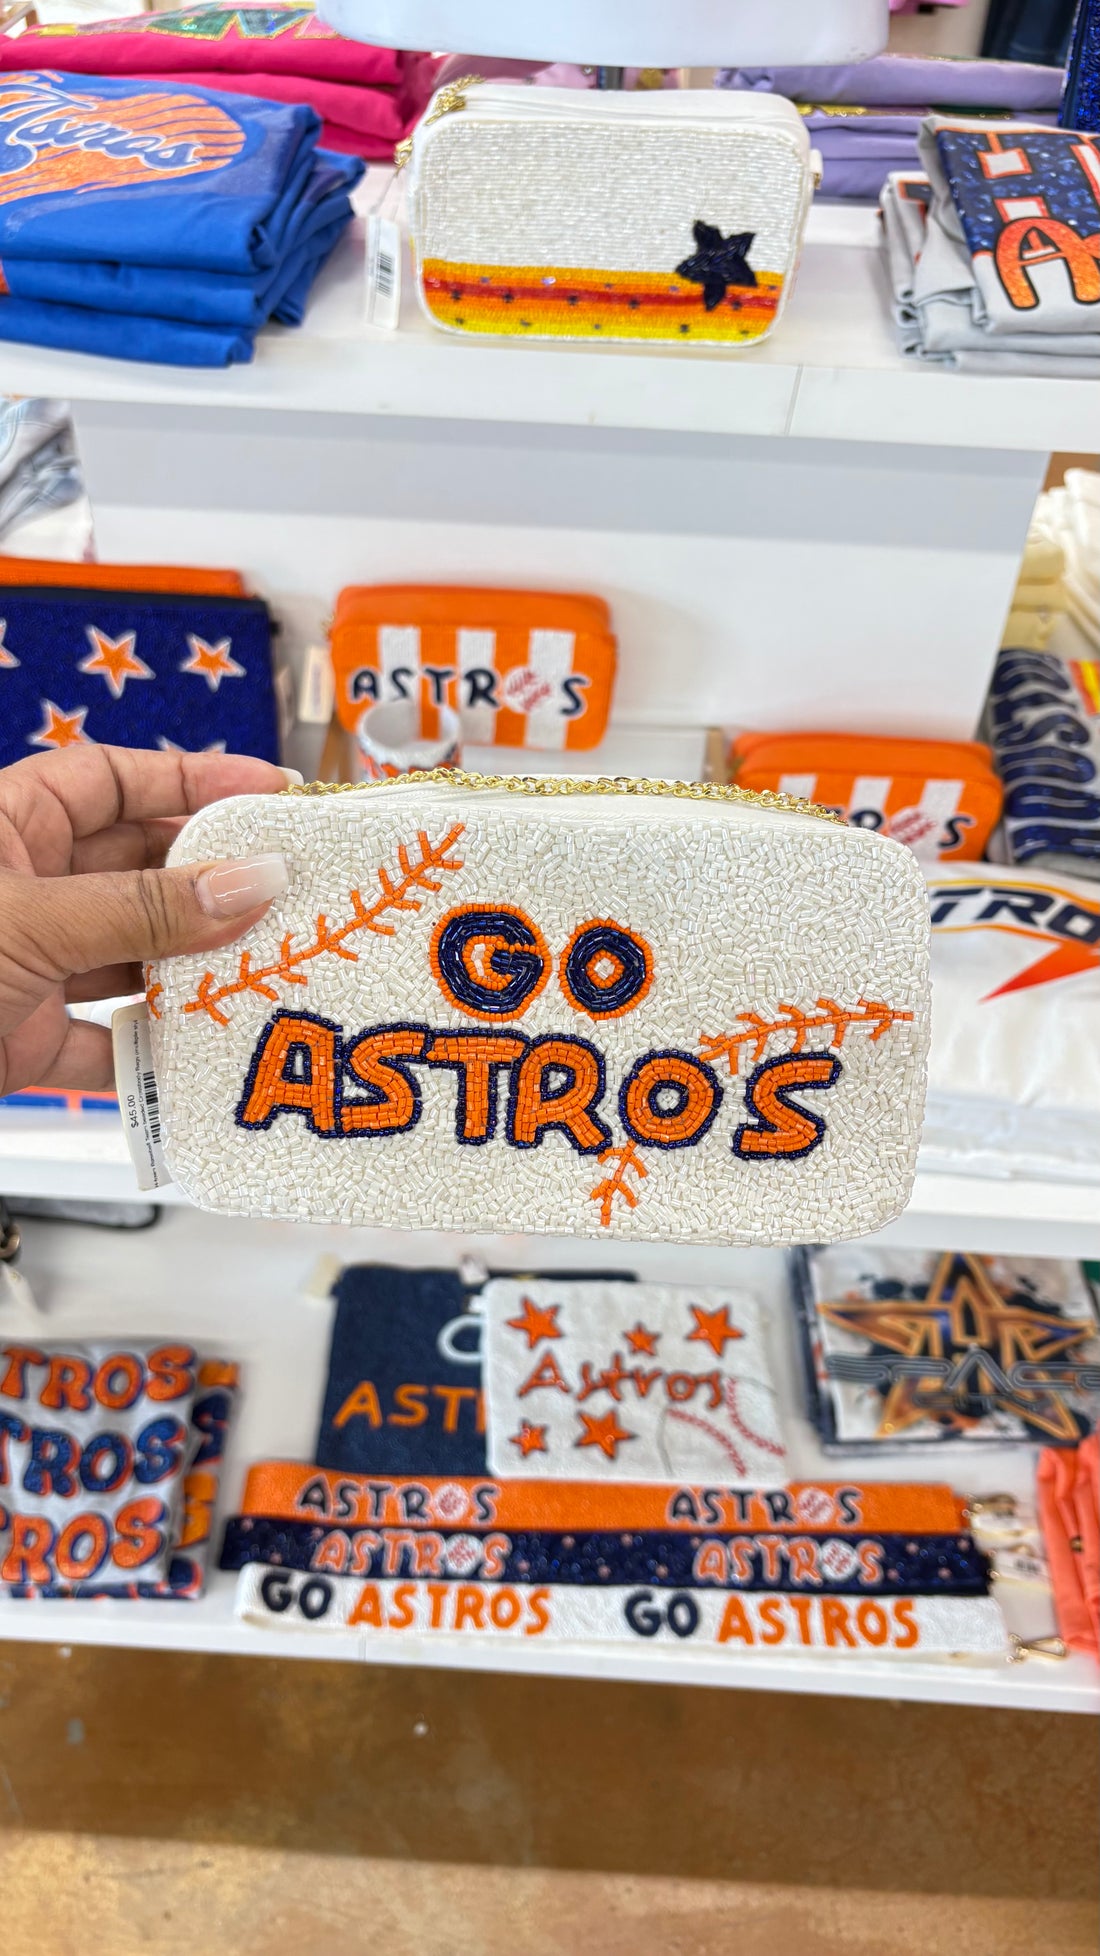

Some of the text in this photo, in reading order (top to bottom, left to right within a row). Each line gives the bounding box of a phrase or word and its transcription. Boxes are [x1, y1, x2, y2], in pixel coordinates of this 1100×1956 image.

[353, 667, 589, 717] ASTROS
[430, 903, 654, 1022] GO
[126, 1094, 139, 1129] $45.00
[234, 1009, 843, 1161] ASTROS
[332, 1379, 487, 1435] AST
[517, 1350, 722, 1410] Astros
[297, 1474, 501, 1524] ASTROS
[667, 1486, 862, 1527] ASTROS
[0, 1497, 167, 1583] ROS
[310, 1529, 513, 1579] ASTROS
[693, 1535, 885, 1587] ASTROS
[261, 1571, 553, 1637] GO ASTROS
[624, 1588, 921, 1649] GO ASTROS
